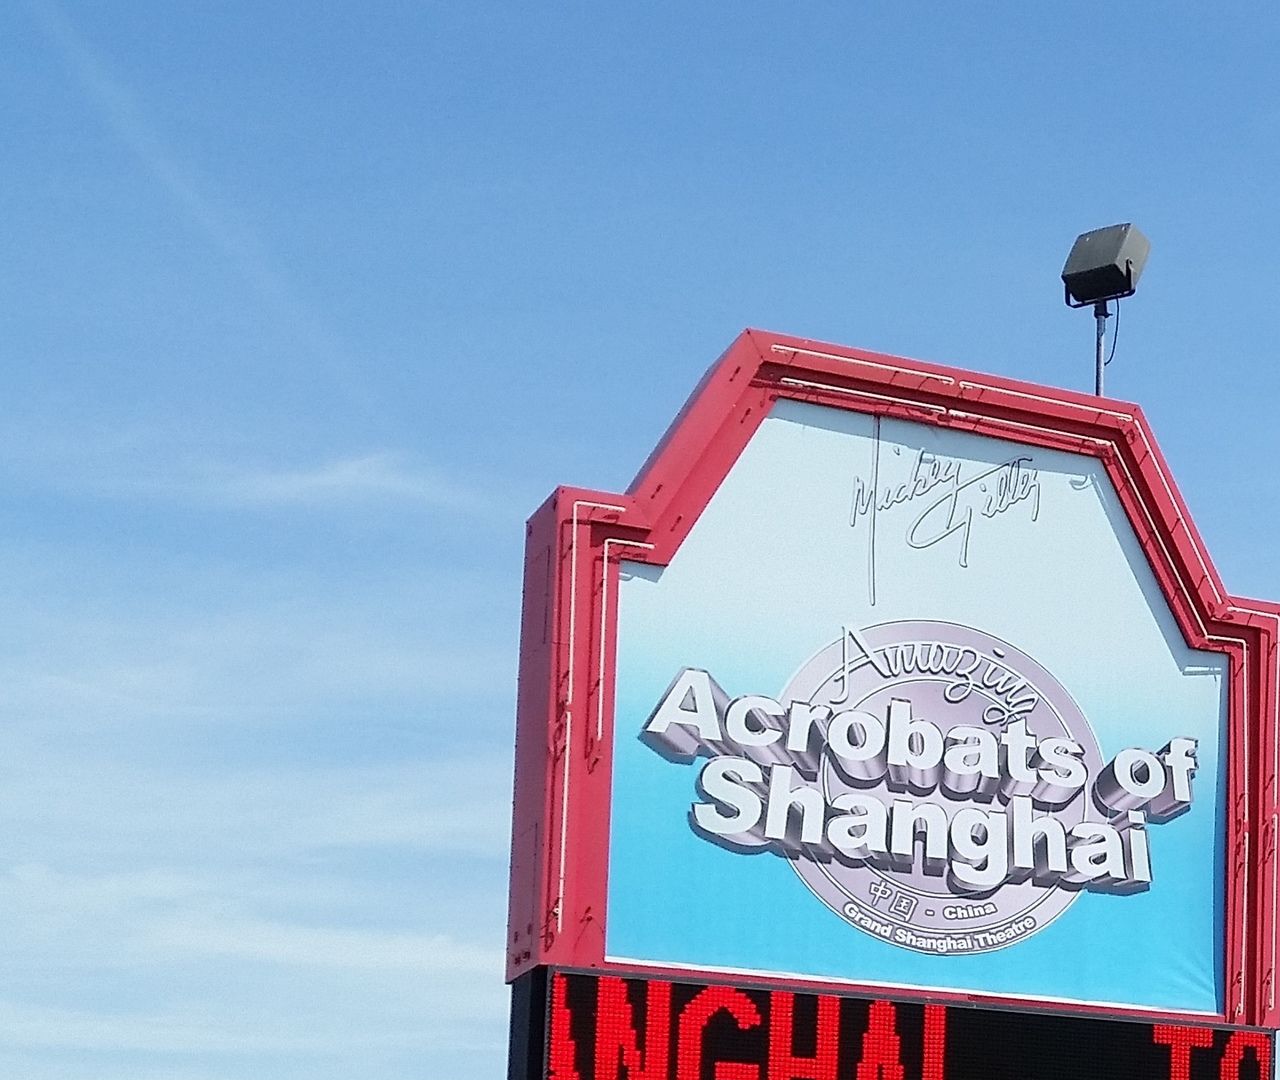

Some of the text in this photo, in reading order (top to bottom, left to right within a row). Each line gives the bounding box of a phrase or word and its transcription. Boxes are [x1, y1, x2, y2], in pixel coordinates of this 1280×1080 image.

[906, 458, 1040, 568] Gilley
[830, 626, 1039, 726] Amazing
[642, 667, 1198, 810] Acrobats of
[690, 755, 1151, 890] Shanghai
[843, 902, 1037, 953] Grand Shanghai Theatre
[869, 880, 918, 922] 中国
[942, 901, 998, 920] China
